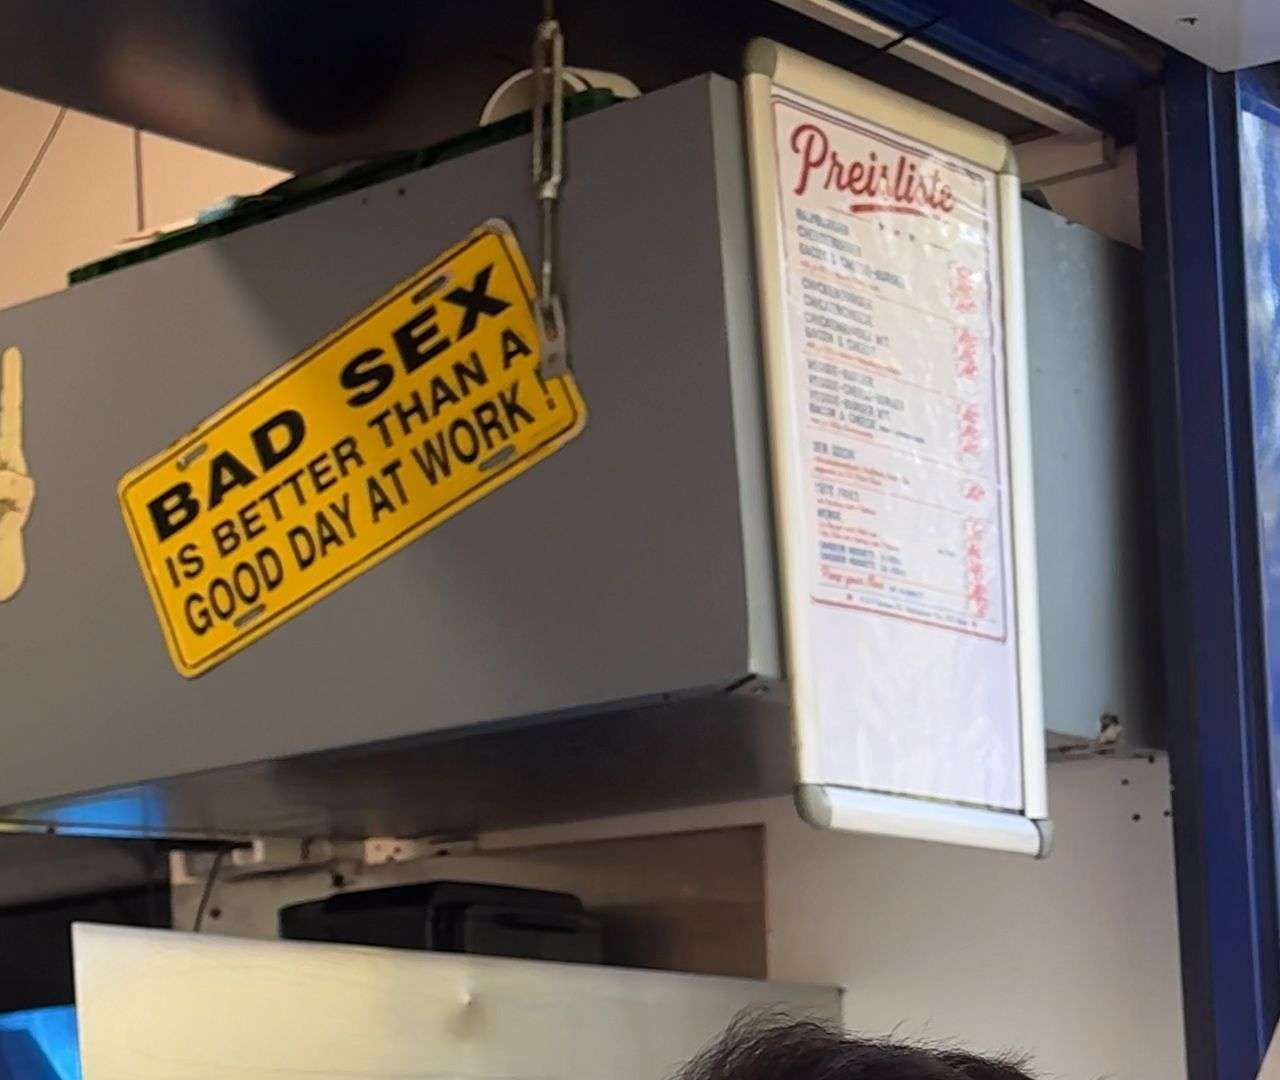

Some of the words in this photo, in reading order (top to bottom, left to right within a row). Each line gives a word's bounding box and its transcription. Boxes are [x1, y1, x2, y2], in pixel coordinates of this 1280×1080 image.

[791, 123, 954, 212] Preisliste
[146, 409, 307, 541] BAD
[339, 264, 513, 408] SEX
[166, 543, 204, 587] IS
[214, 436, 364, 555] BETTER
[369, 353, 490, 447] THAN
[502, 329, 532, 368] A
[183, 552, 285, 637] GOOD
[288, 497, 358, 570] DAY
[368, 458, 409, 524] AT
[411, 384, 536, 486] WORK
